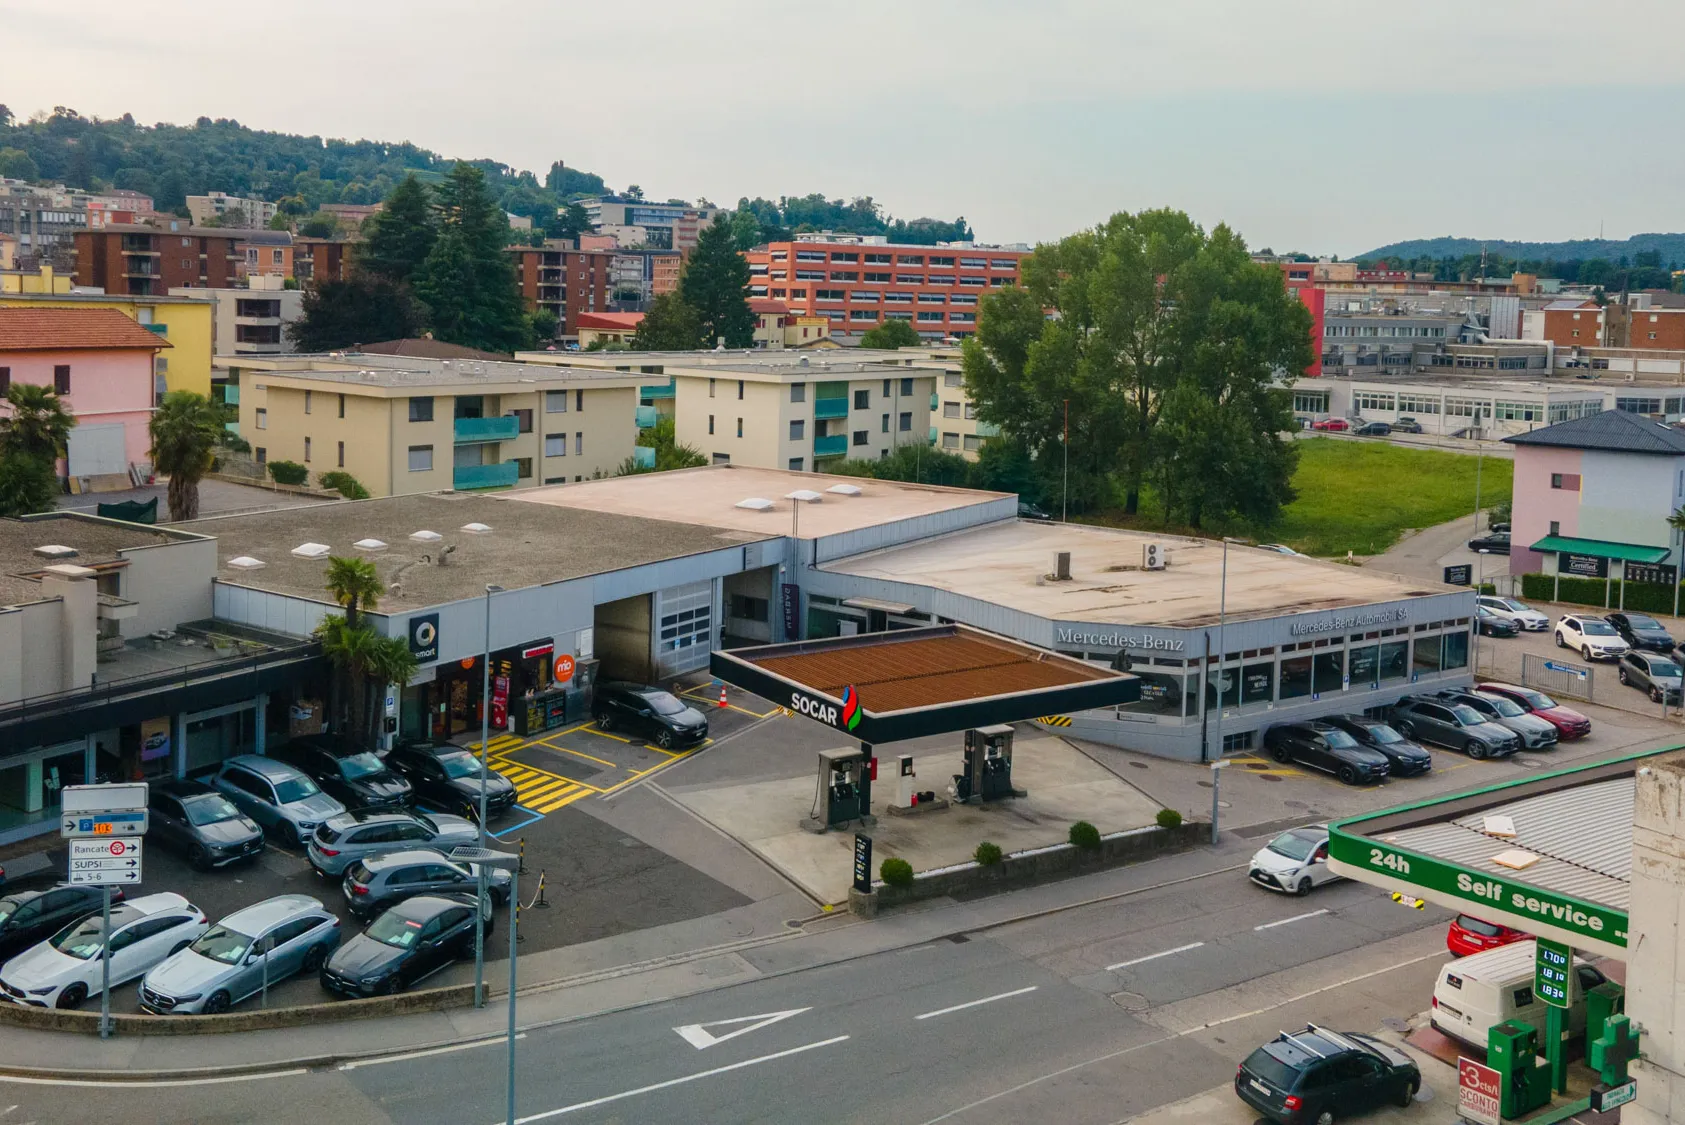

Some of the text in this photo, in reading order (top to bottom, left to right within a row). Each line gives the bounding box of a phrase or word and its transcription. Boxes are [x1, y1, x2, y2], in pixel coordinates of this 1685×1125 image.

[1292, 607, 1408, 637] Mercedes-Benz Automobili SA
[1056, 627, 1184, 651] Mercedes-Benz
[415, 648, 435, 658] smart
[557, 660, 571, 672] mio
[791, 692, 837, 726] SOCAR
[74, 845, 109, 854] Rancate
[1370, 849, 1410, 874] 24h
[74, 860, 102, 869] SUPSI
[87, 873, 102, 881] 5-6
[1457, 873, 1604, 931] Self service
[1460, 1088, 1498, 1112] SCONTO
